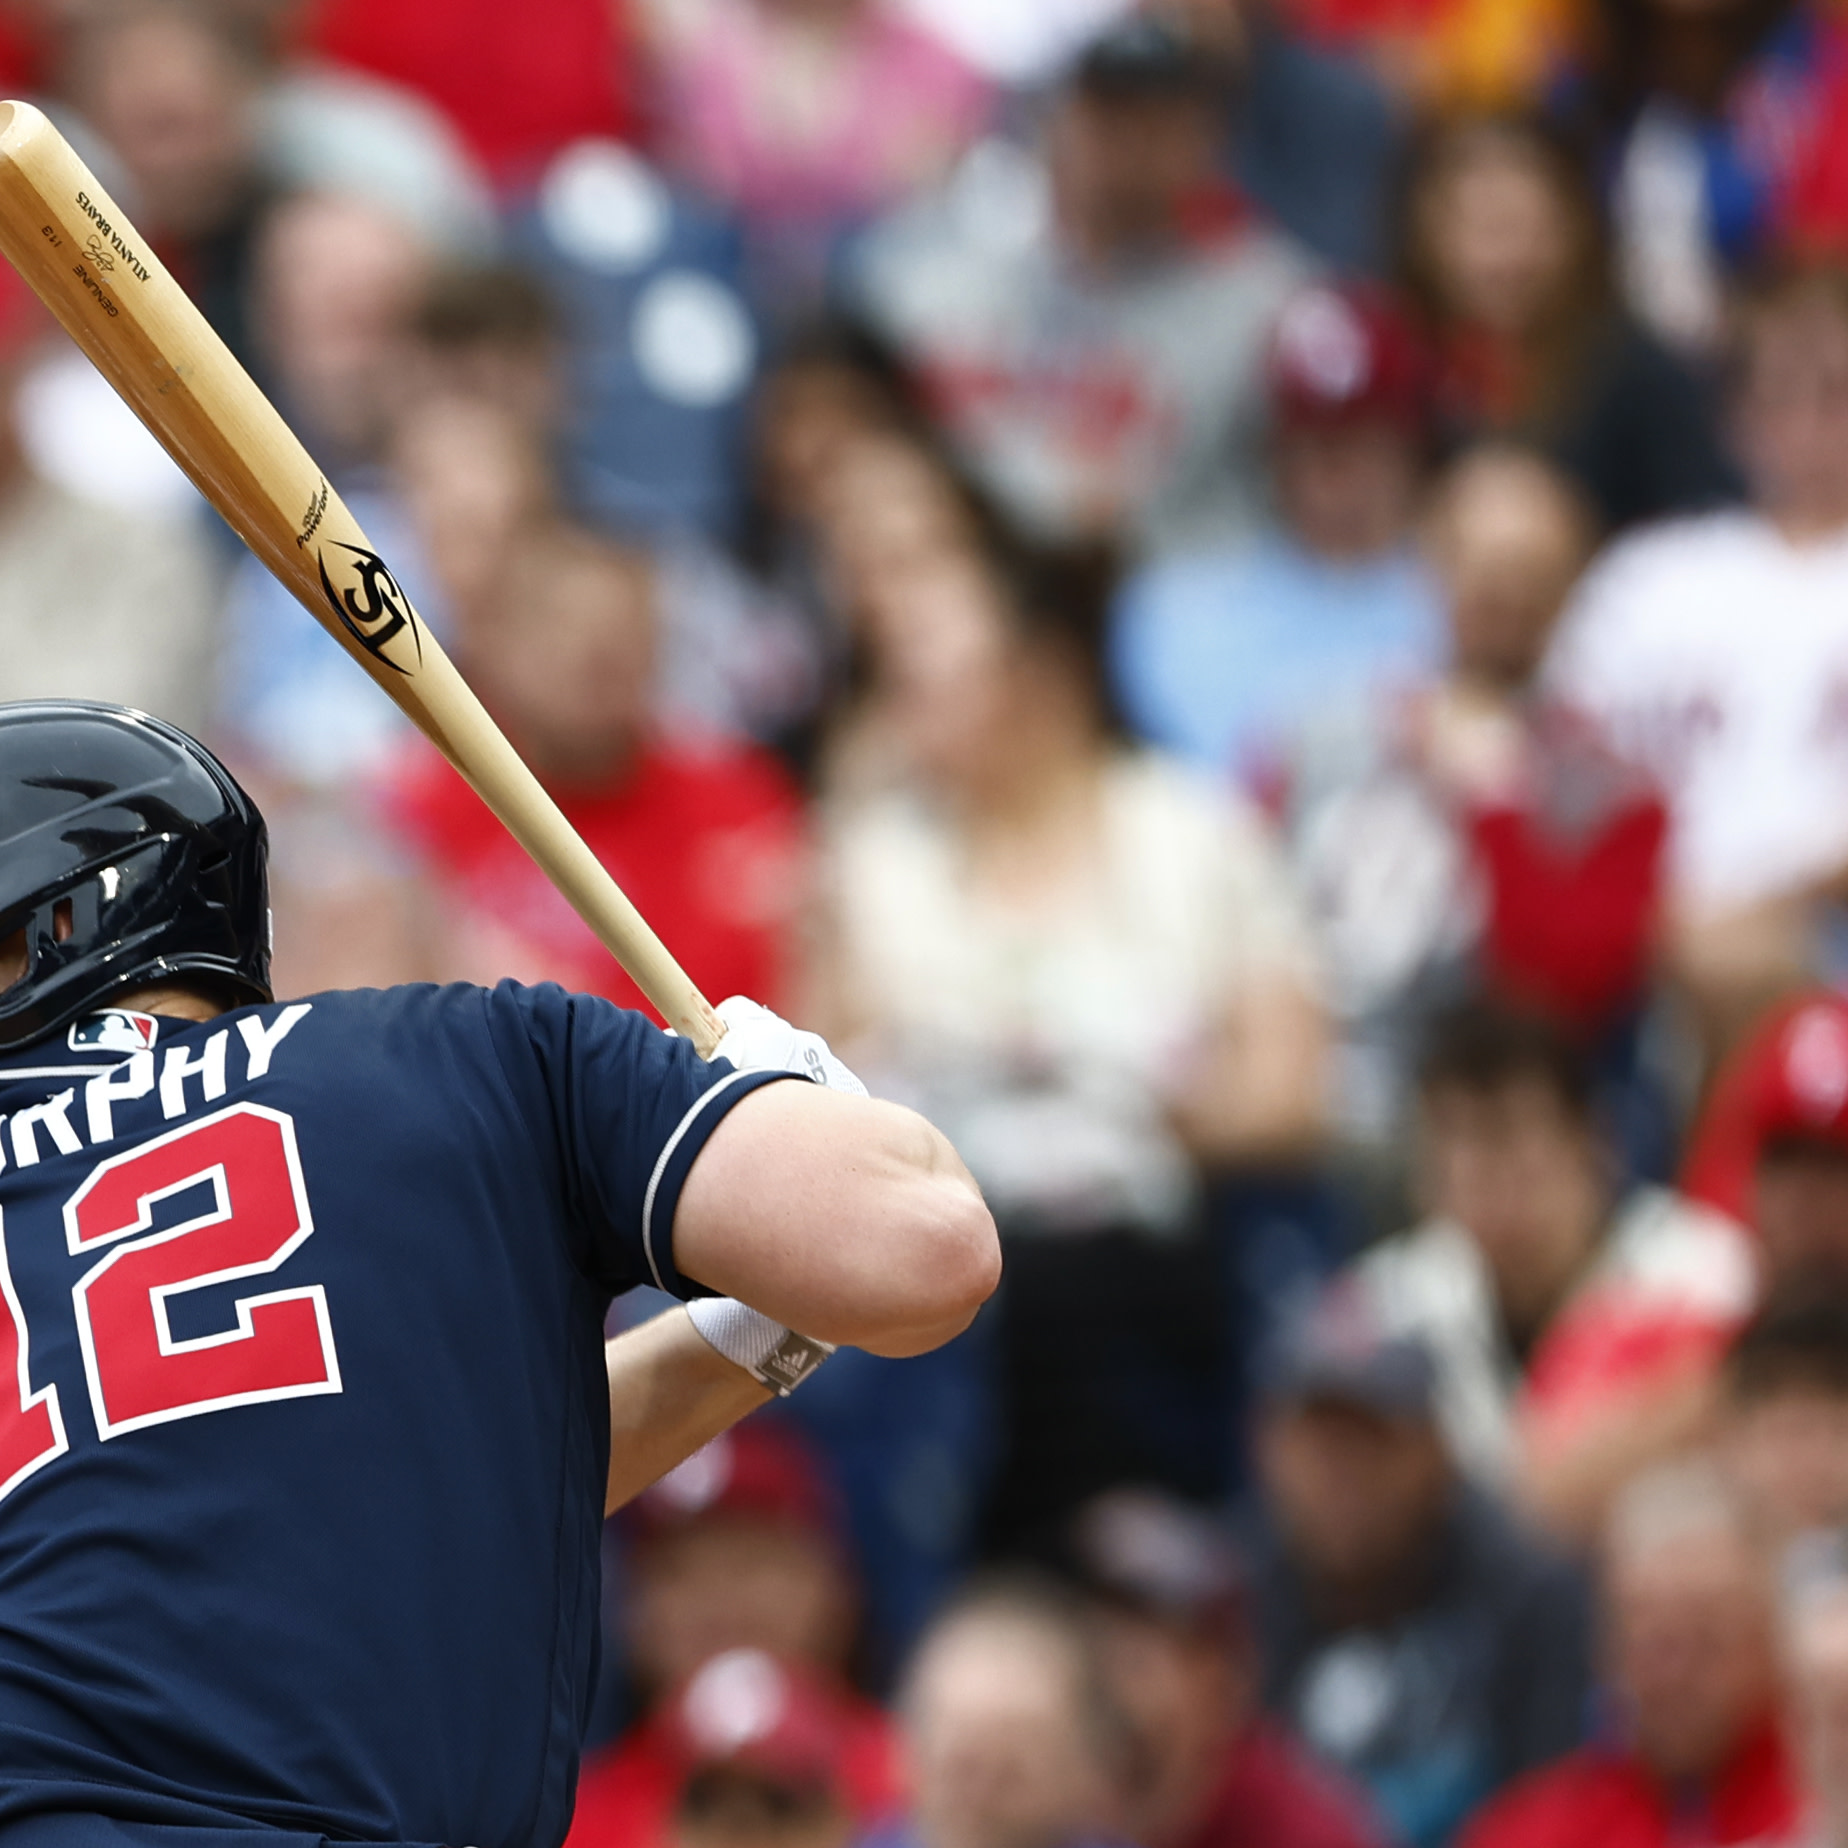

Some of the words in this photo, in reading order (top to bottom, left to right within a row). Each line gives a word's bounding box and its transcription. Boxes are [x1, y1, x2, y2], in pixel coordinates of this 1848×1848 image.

[75, 190, 114, 234] BRAVES
[107, 229, 152, 284] ATLANTA
[72, 263, 119, 318] GENUINE
